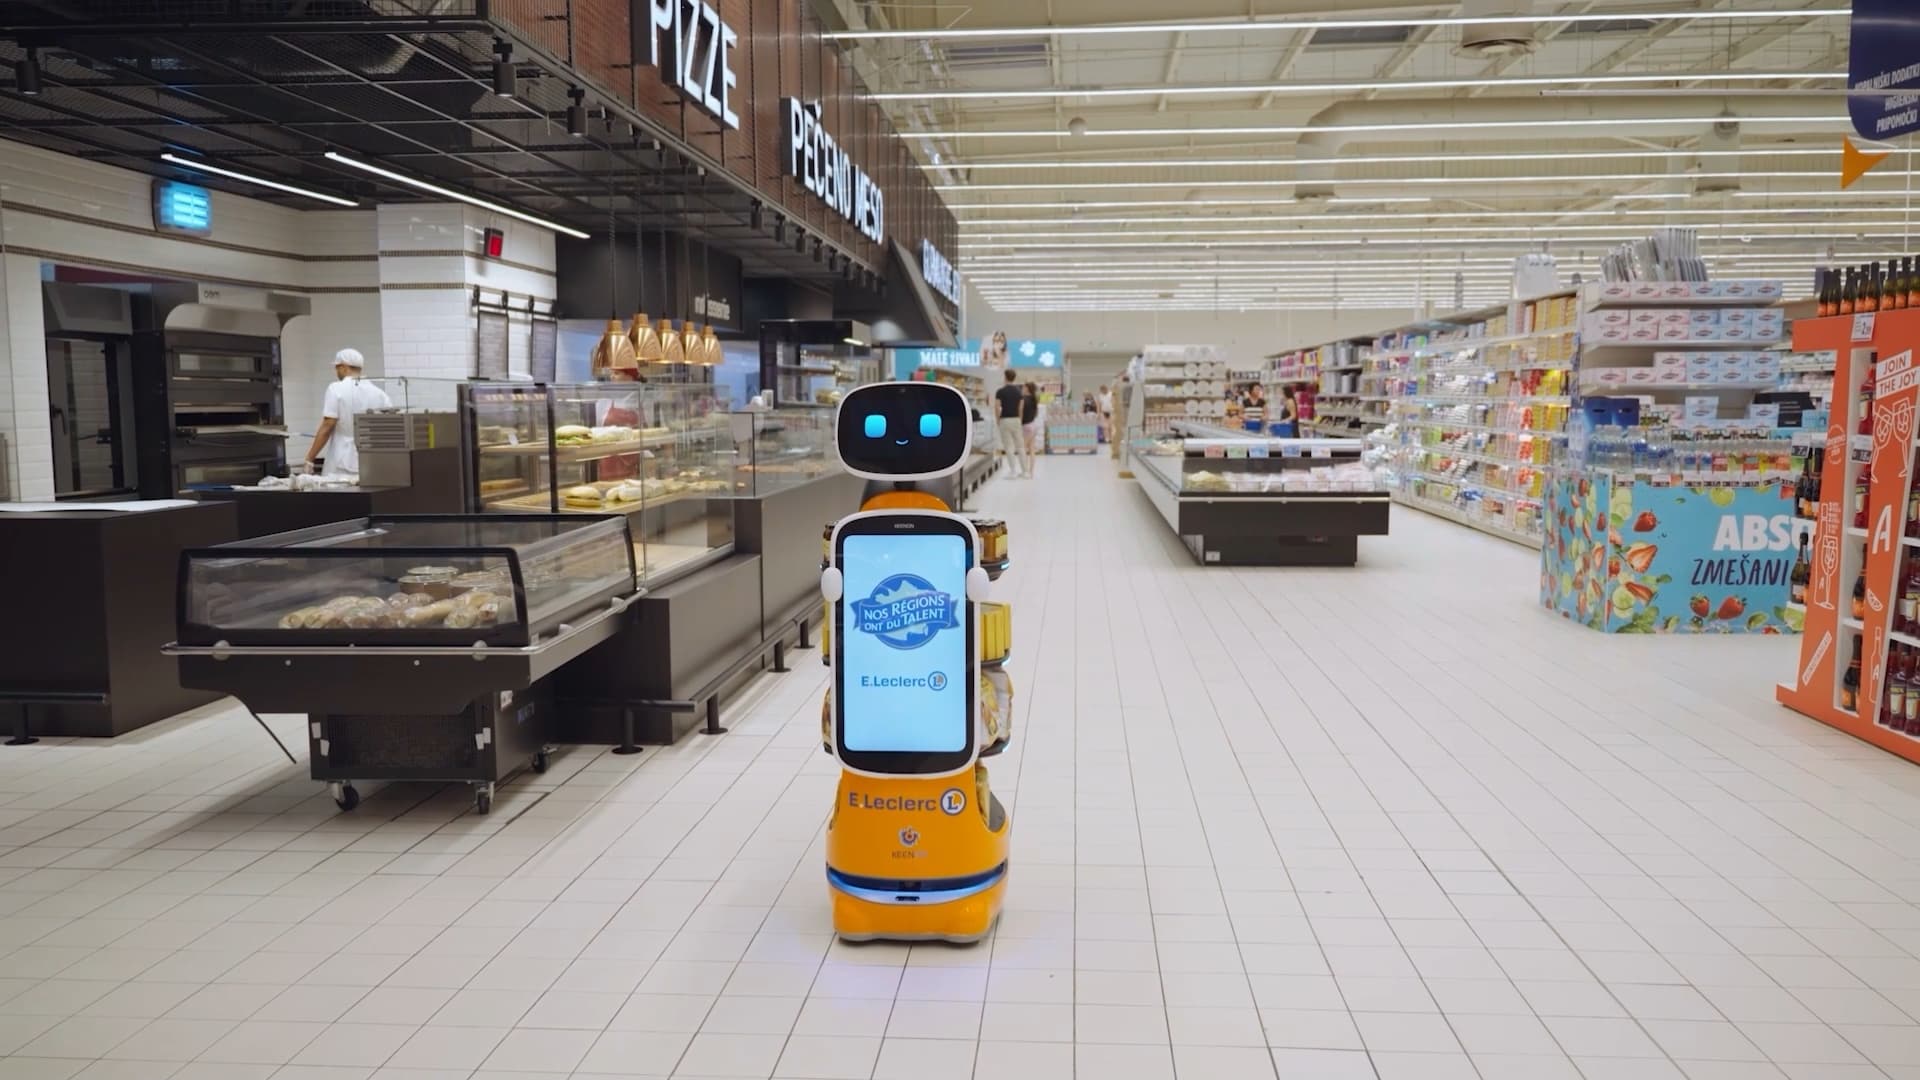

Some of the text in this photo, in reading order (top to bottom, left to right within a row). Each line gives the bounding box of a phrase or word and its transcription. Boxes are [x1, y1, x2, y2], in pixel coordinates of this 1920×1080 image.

[650, 0, 740, 131] PIZZE
[790, 96, 883, 245] PEČENO MESO
[1883, 355, 1906, 375] JOIN
[1880, 370, 1917, 395] THE JOY
[1872, 504, 1892, 554] A
[1691, 553, 1789, 586] ZMEŠANI
[864, 594, 945, 620] NOS RÉGIONS
[864, 608, 945, 631] ONT DU TALENT
[861, 675, 926, 687] E.Leclerc
[849, 791, 937, 811] E.Leclerc
